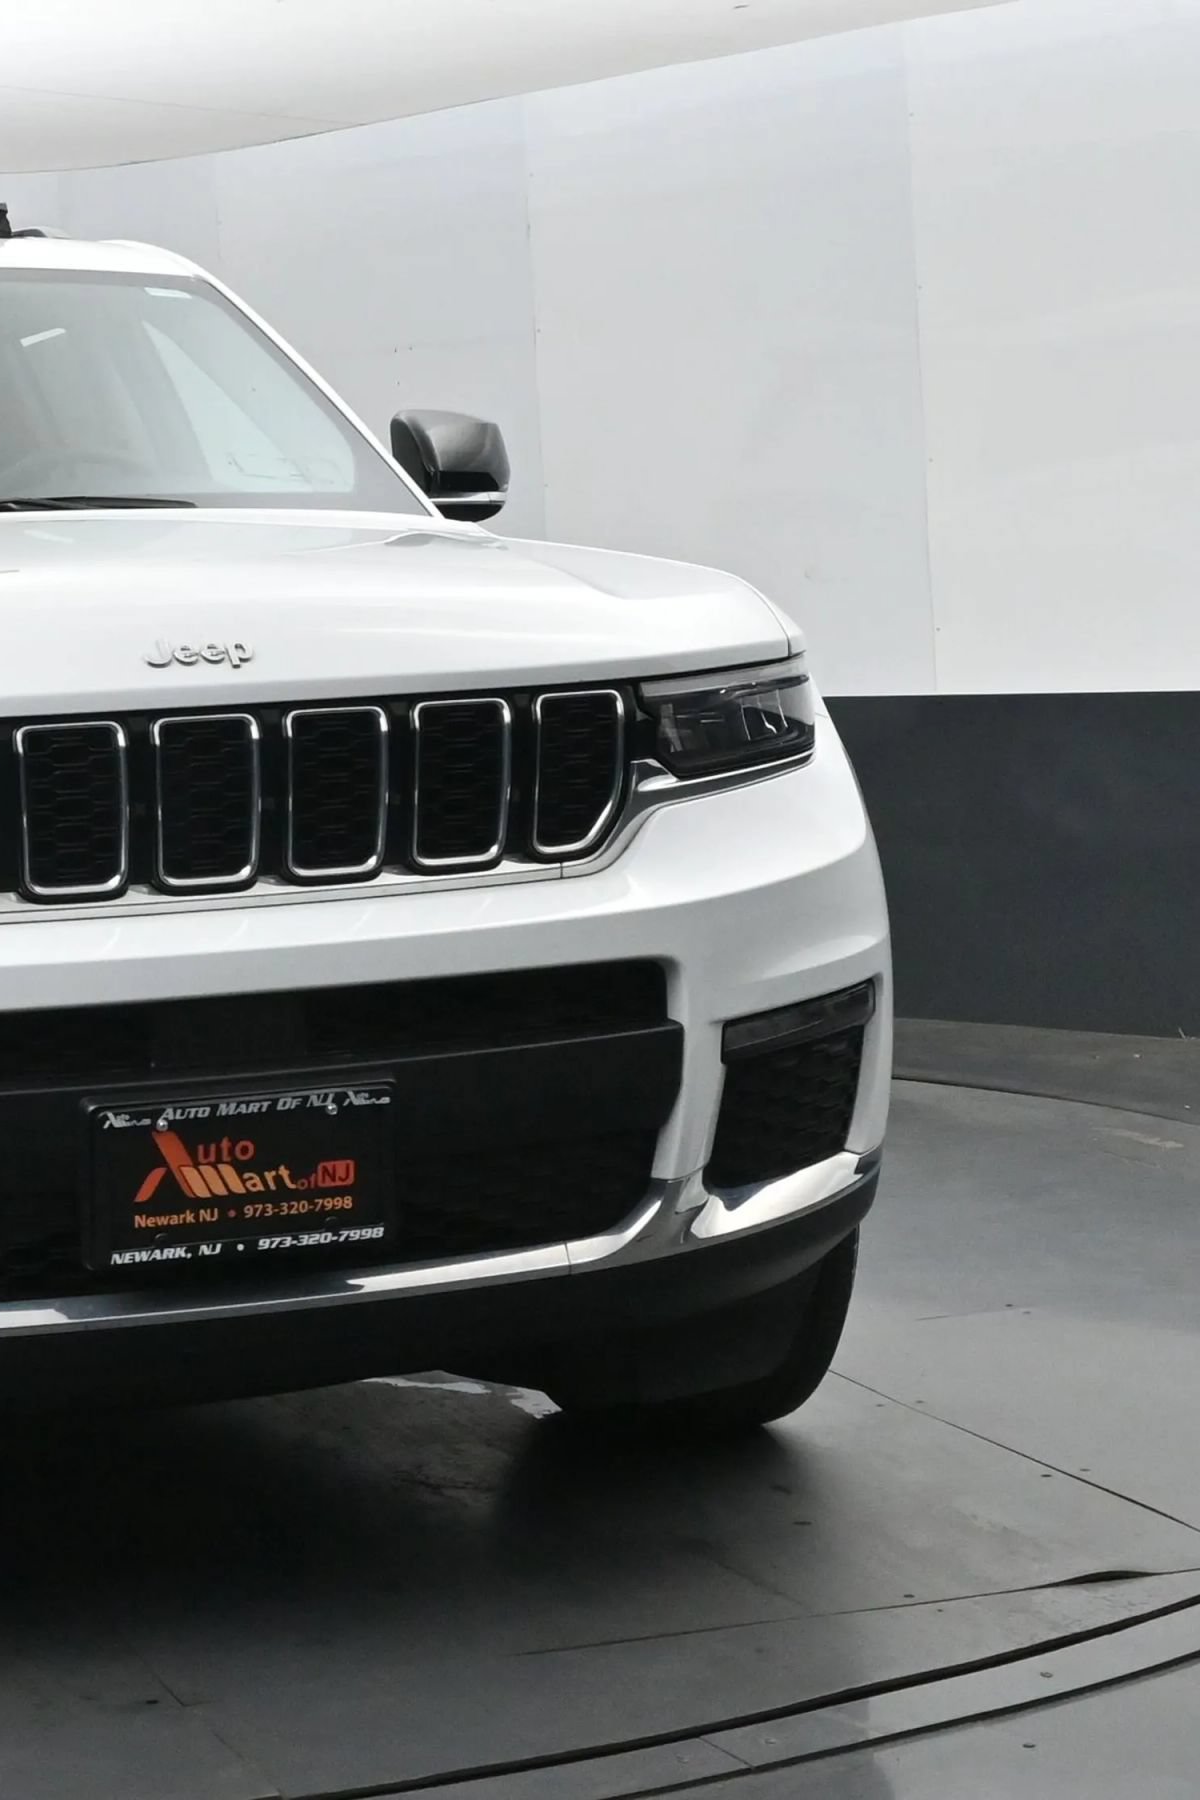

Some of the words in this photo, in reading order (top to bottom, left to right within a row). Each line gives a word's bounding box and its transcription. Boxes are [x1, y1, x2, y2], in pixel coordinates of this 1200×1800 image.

[144, 639, 254, 669] Jeep
[134, 1131, 254, 1202] Auto
[179, 1163, 297, 1198] Mart
[297, 1172, 318, 1190] of
[321, 1162, 352, 1184] NJ
[134, 1210, 195, 1228] Newark
[199, 1208, 219, 1222] NJ
[243, 1196, 353, 1218] 973-320-7998
[110, 1246, 193, 1265] NEWARK,
[198, 1243, 222, 1256] NJ
[257, 1227, 385, 1250] 973-320-7998
